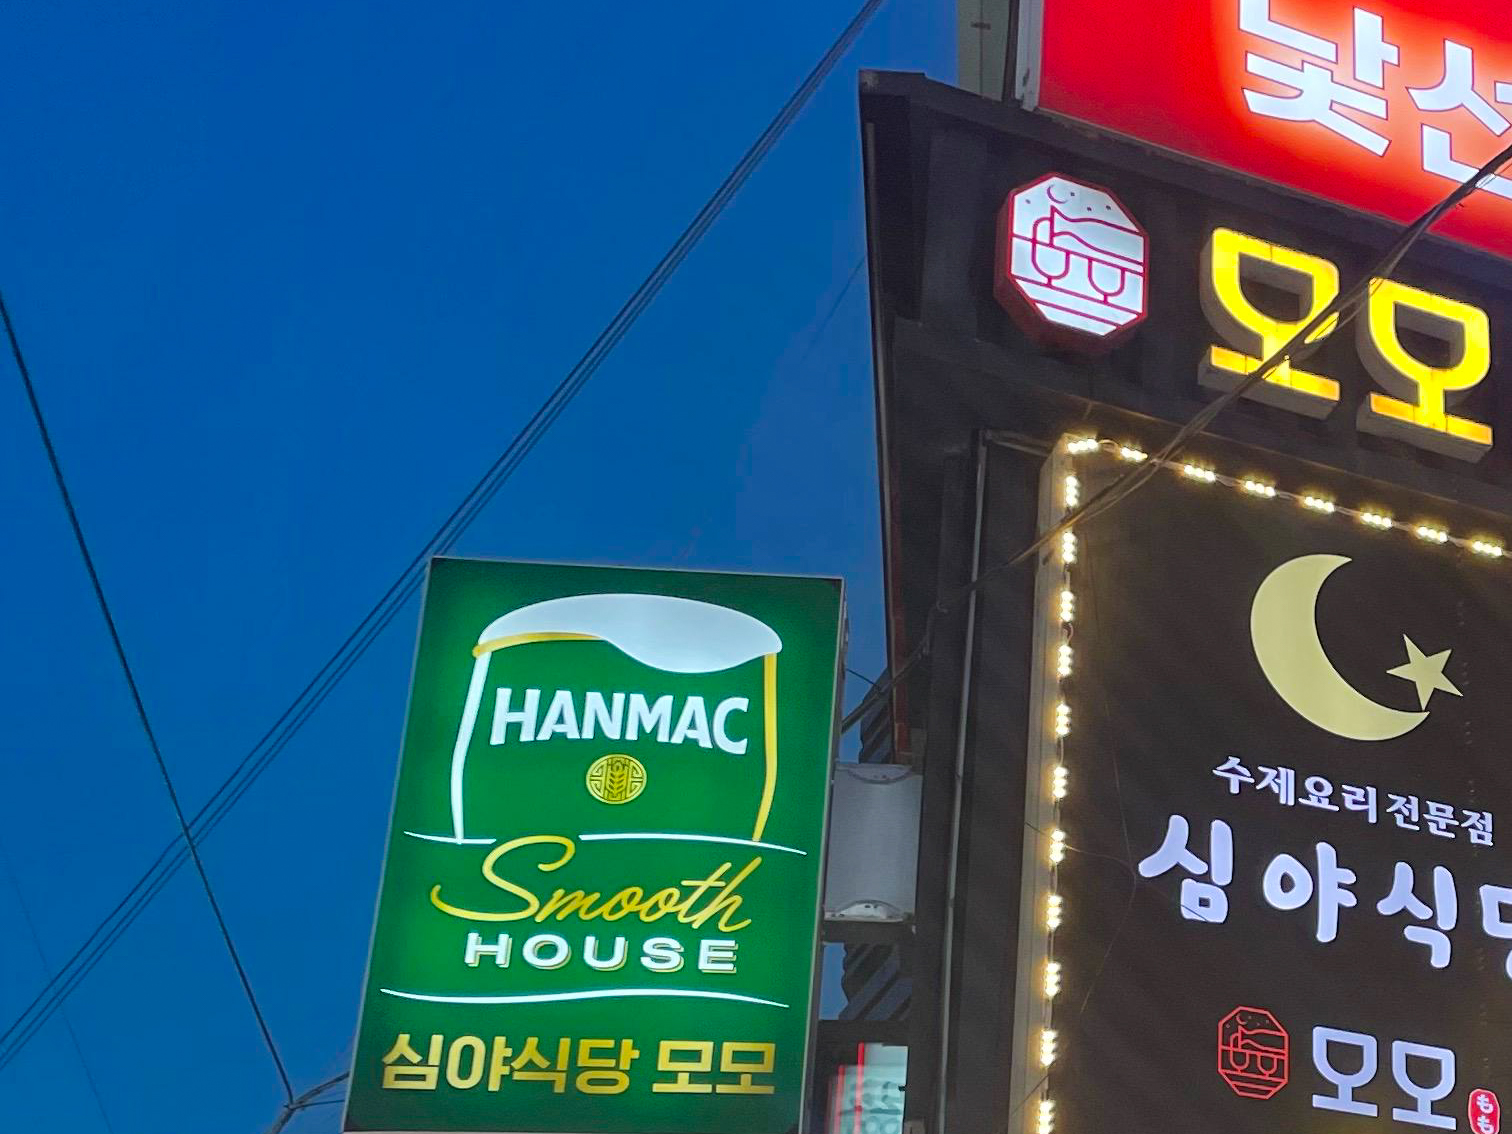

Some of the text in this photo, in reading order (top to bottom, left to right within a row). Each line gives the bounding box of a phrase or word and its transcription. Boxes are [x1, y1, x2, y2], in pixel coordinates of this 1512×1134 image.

[1208, 225, 1494, 447] 모모
[489, 687, 750, 755] HANMAC
[430, 834, 763, 933] Smooth
[463, 931, 739, 975] HOUSE
[380, 1033, 776, 1095] 심야식당 모모
[1311, 1025, 1457, 1131] 모모
